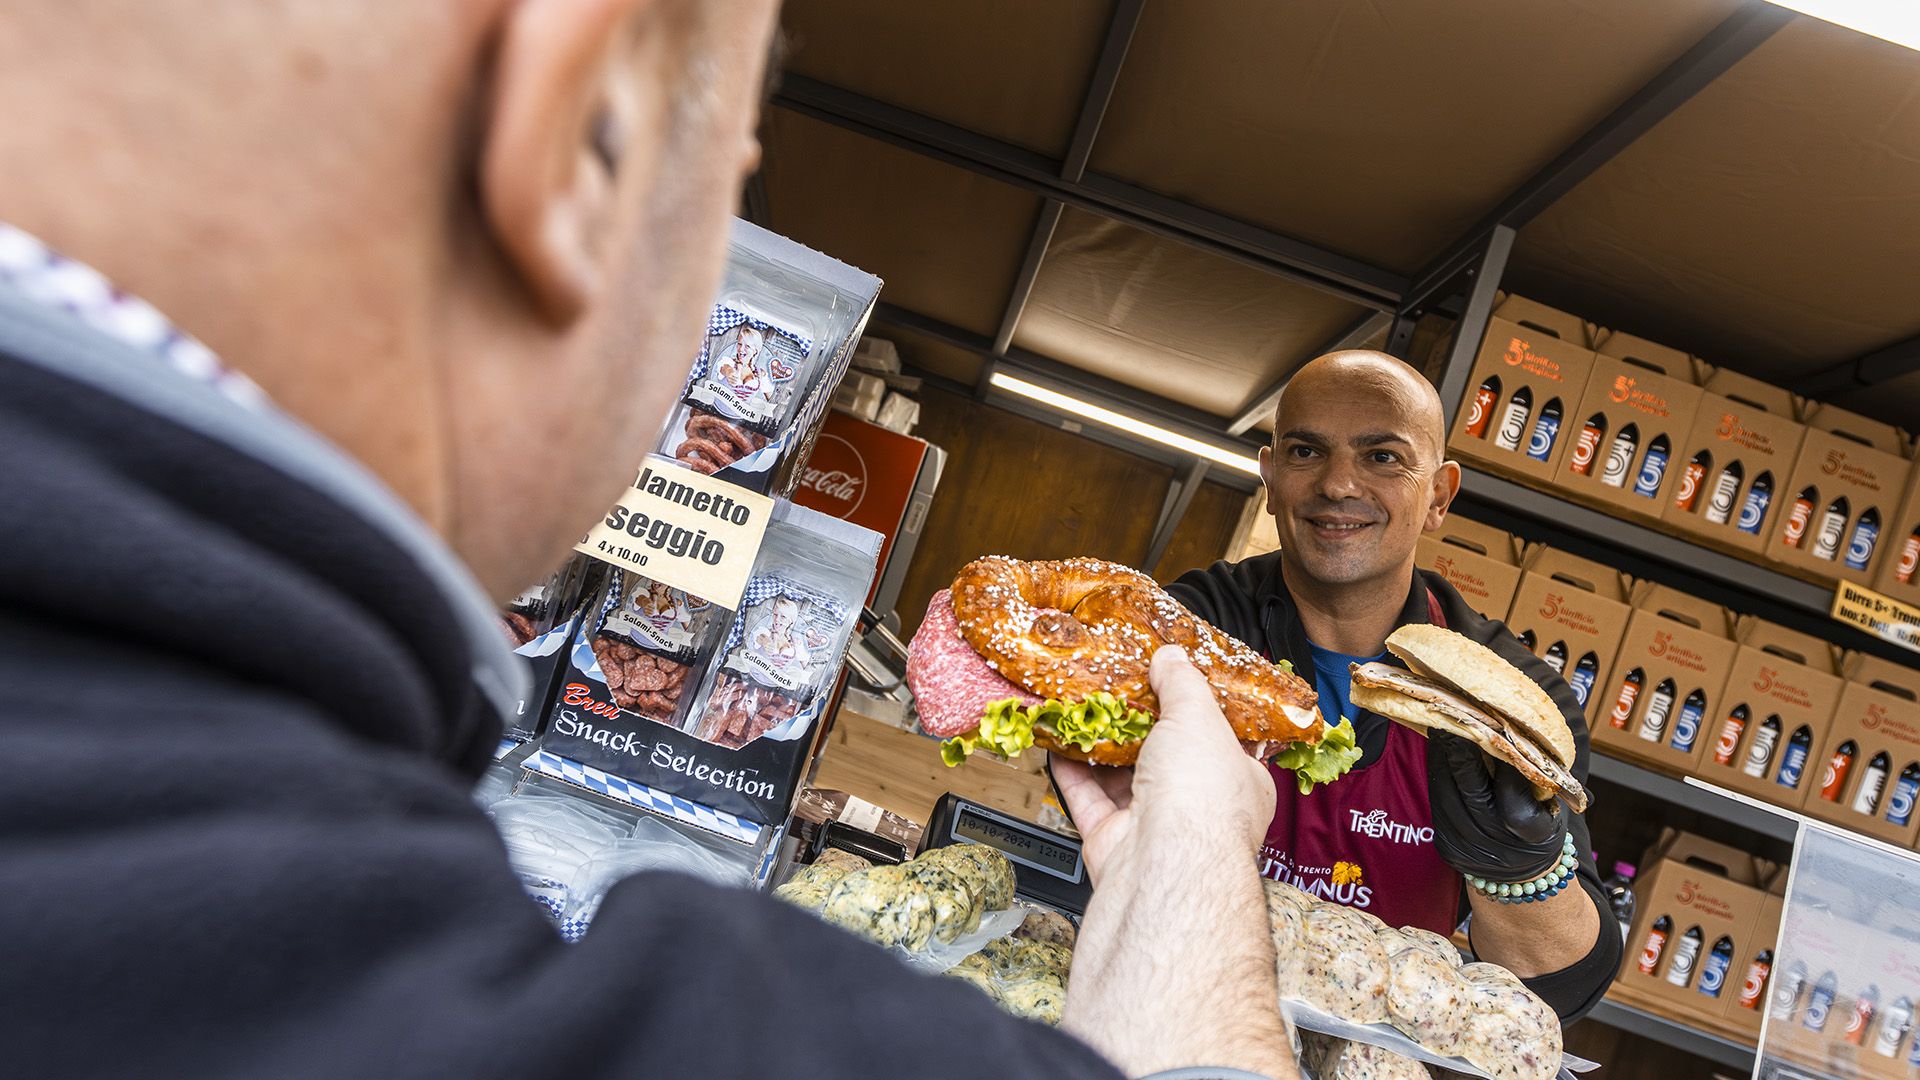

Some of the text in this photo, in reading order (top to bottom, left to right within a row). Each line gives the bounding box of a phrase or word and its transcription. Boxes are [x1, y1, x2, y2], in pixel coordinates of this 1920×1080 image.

[709, 383, 756, 419] Salami-Snack
[633, 468, 751, 526] lametto
[598, 540, 607, 551] 4
[607, 545, 615, 554] x
[617, 547, 649, 567] 10.00
[1451, 569, 1485, 587] birrificio
[623, 614, 674, 649] Salami-Snack
[1558, 617, 1599, 636] artigianale
[1560, 607, 1595, 624] birrificio
[744, 652, 792, 686] Salami-Snack
[650, 741, 775, 800] Selection
[961, 816, 1074, 866] 10/10/2024 12:02
[1349, 809, 1435, 846] TRENTINO
[1298, 865, 1332, 876] TRENTO
